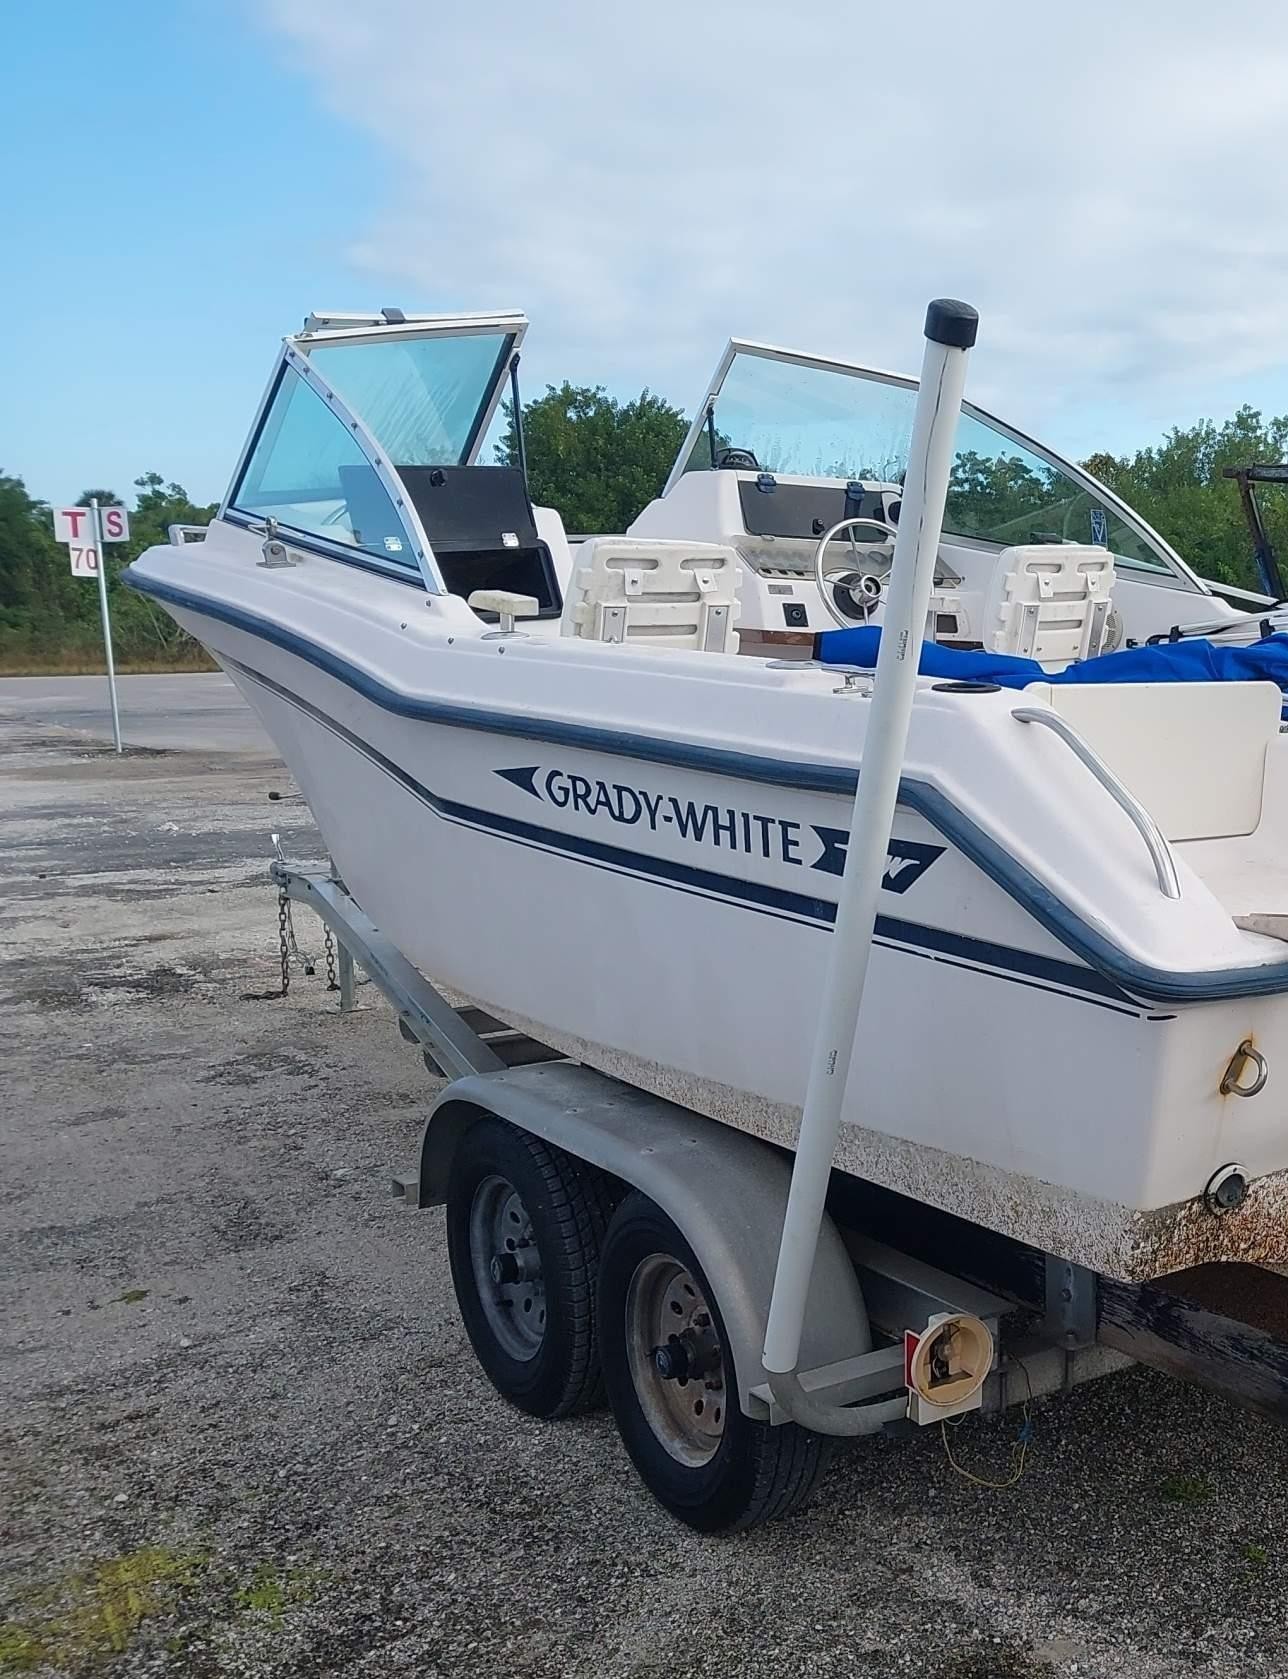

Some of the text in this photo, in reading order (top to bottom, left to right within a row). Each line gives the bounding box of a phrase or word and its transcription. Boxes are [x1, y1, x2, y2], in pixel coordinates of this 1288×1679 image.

[62, 511, 86, 538] T
[106, 511, 123, 538] S
[71, 547, 98, 570] 70
[545, 769, 804, 867] GRADY-WHITE
